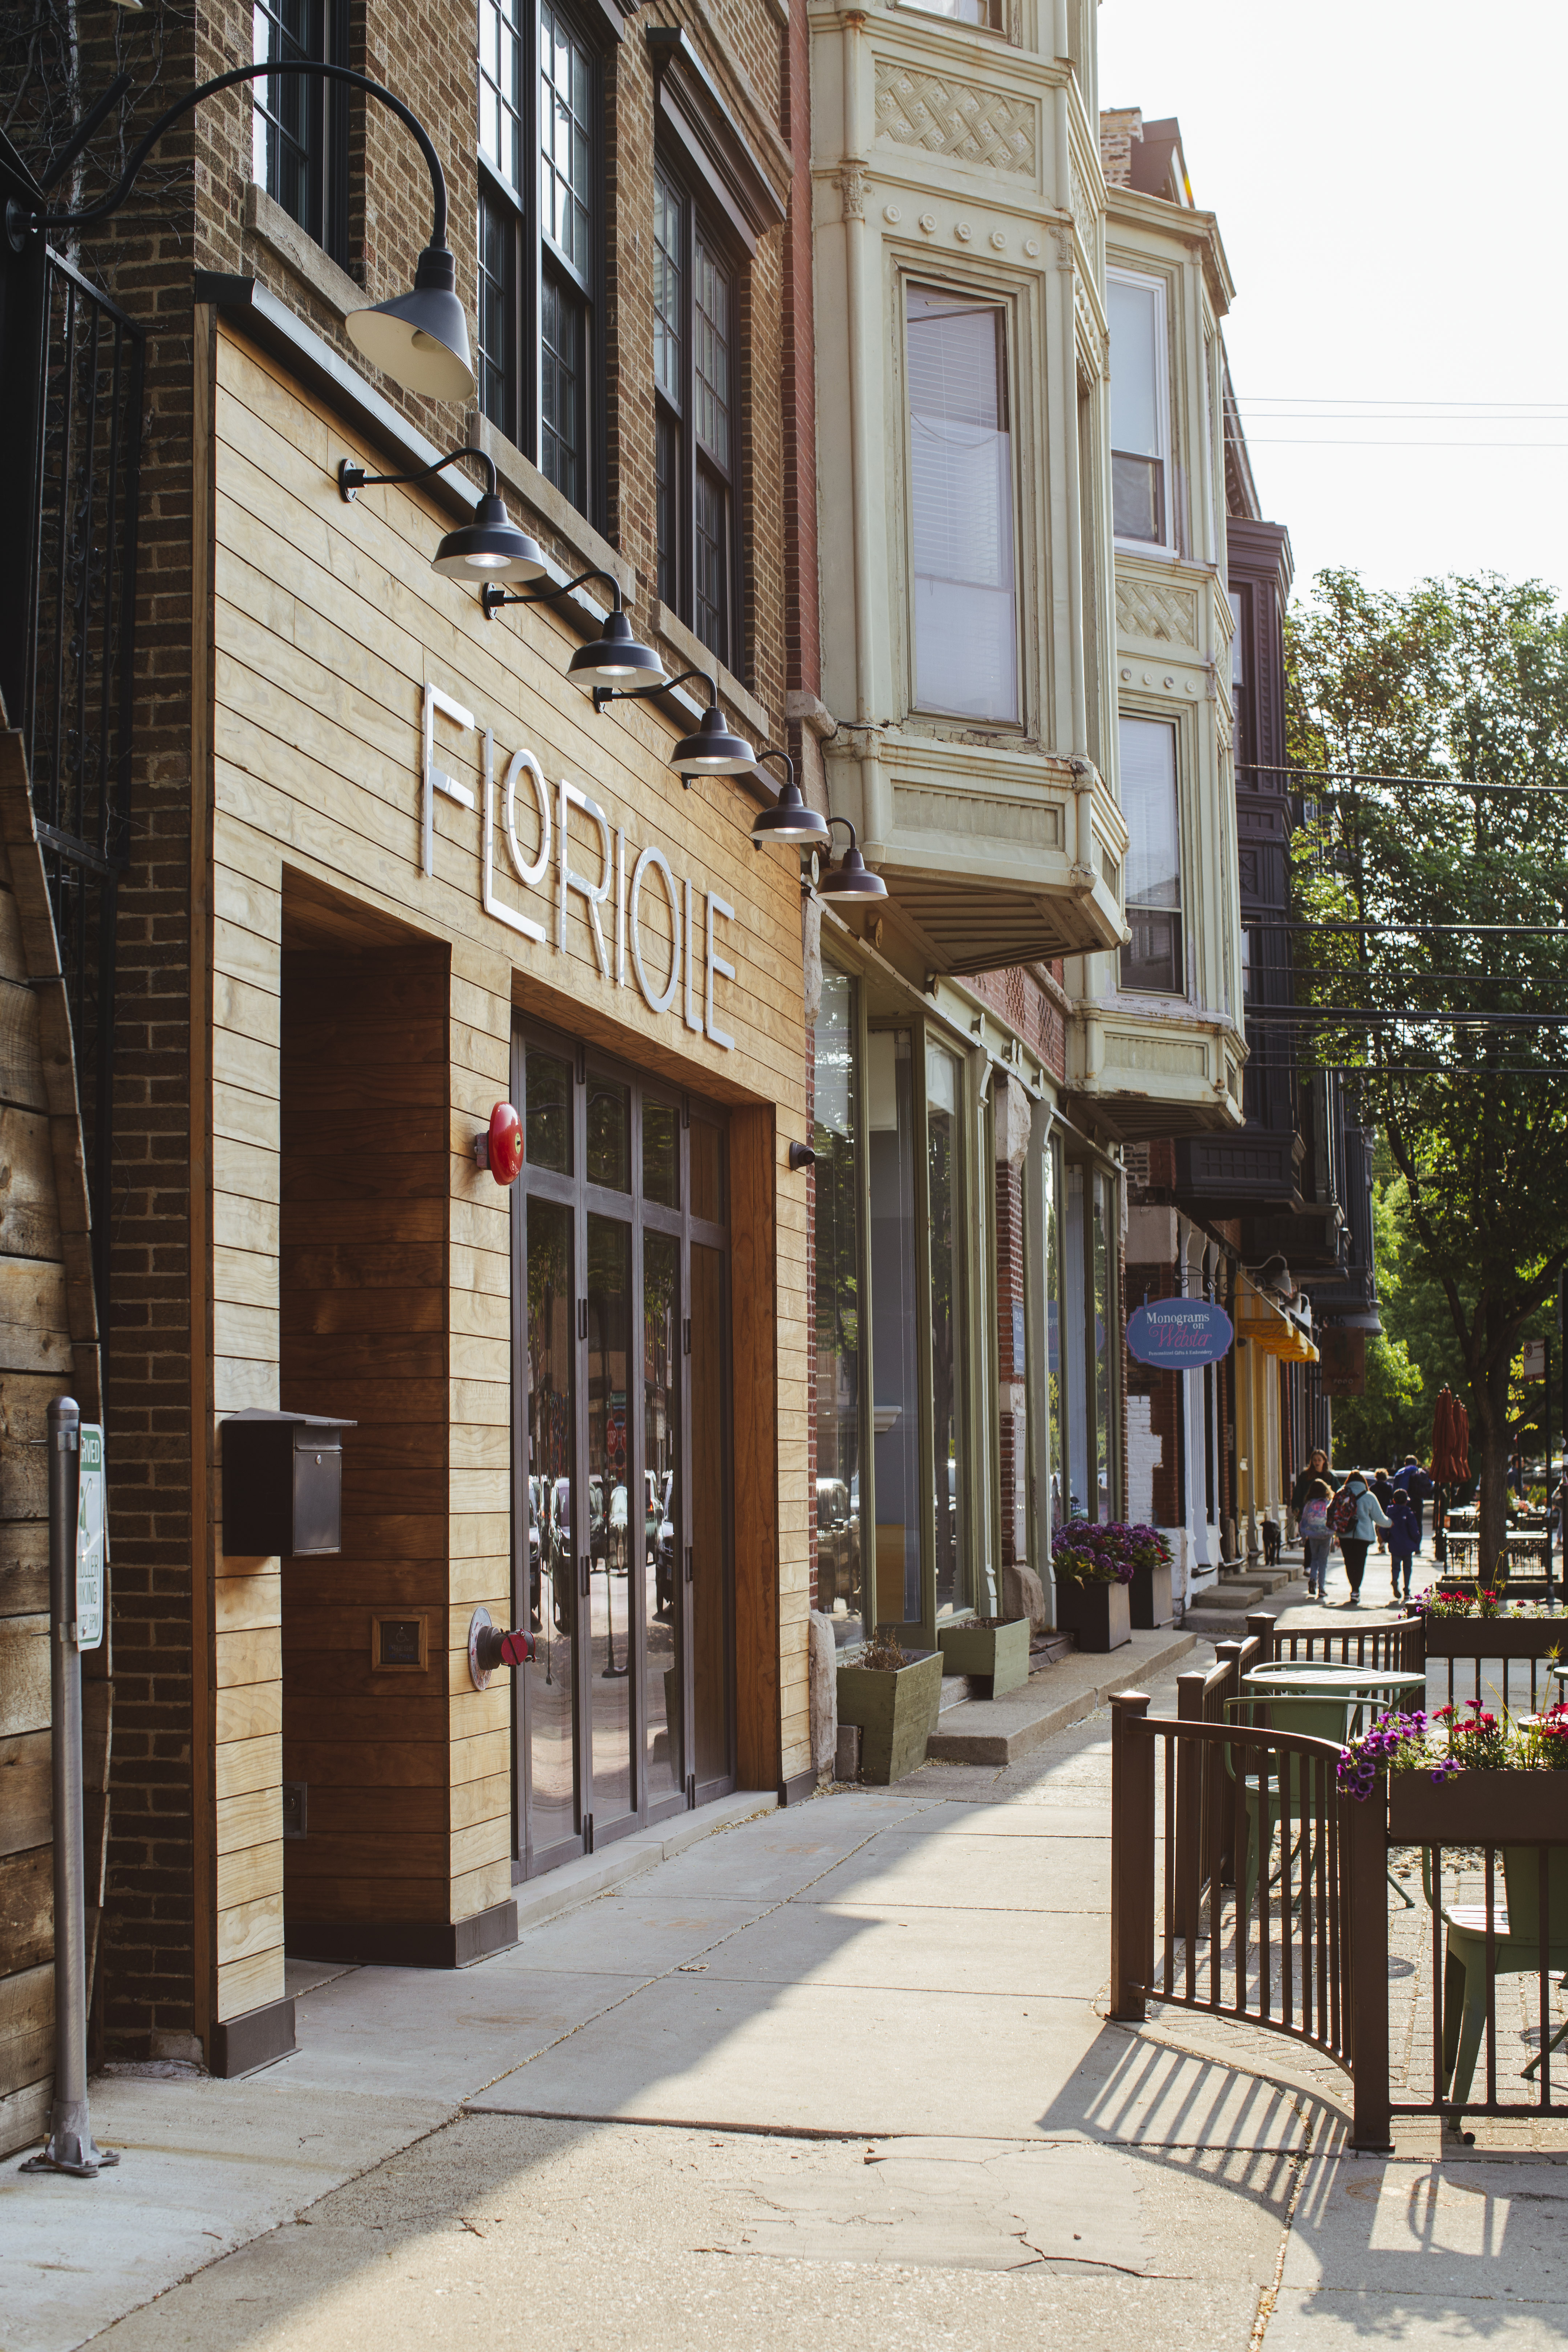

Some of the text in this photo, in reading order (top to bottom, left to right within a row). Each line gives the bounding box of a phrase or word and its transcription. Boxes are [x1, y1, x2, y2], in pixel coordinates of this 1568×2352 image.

[424, 682, 735, 1050] FLORIOLE
[1147, 1312, 1210, 1326] Monograms
[1149, 1324, 1212, 1347] Webster
